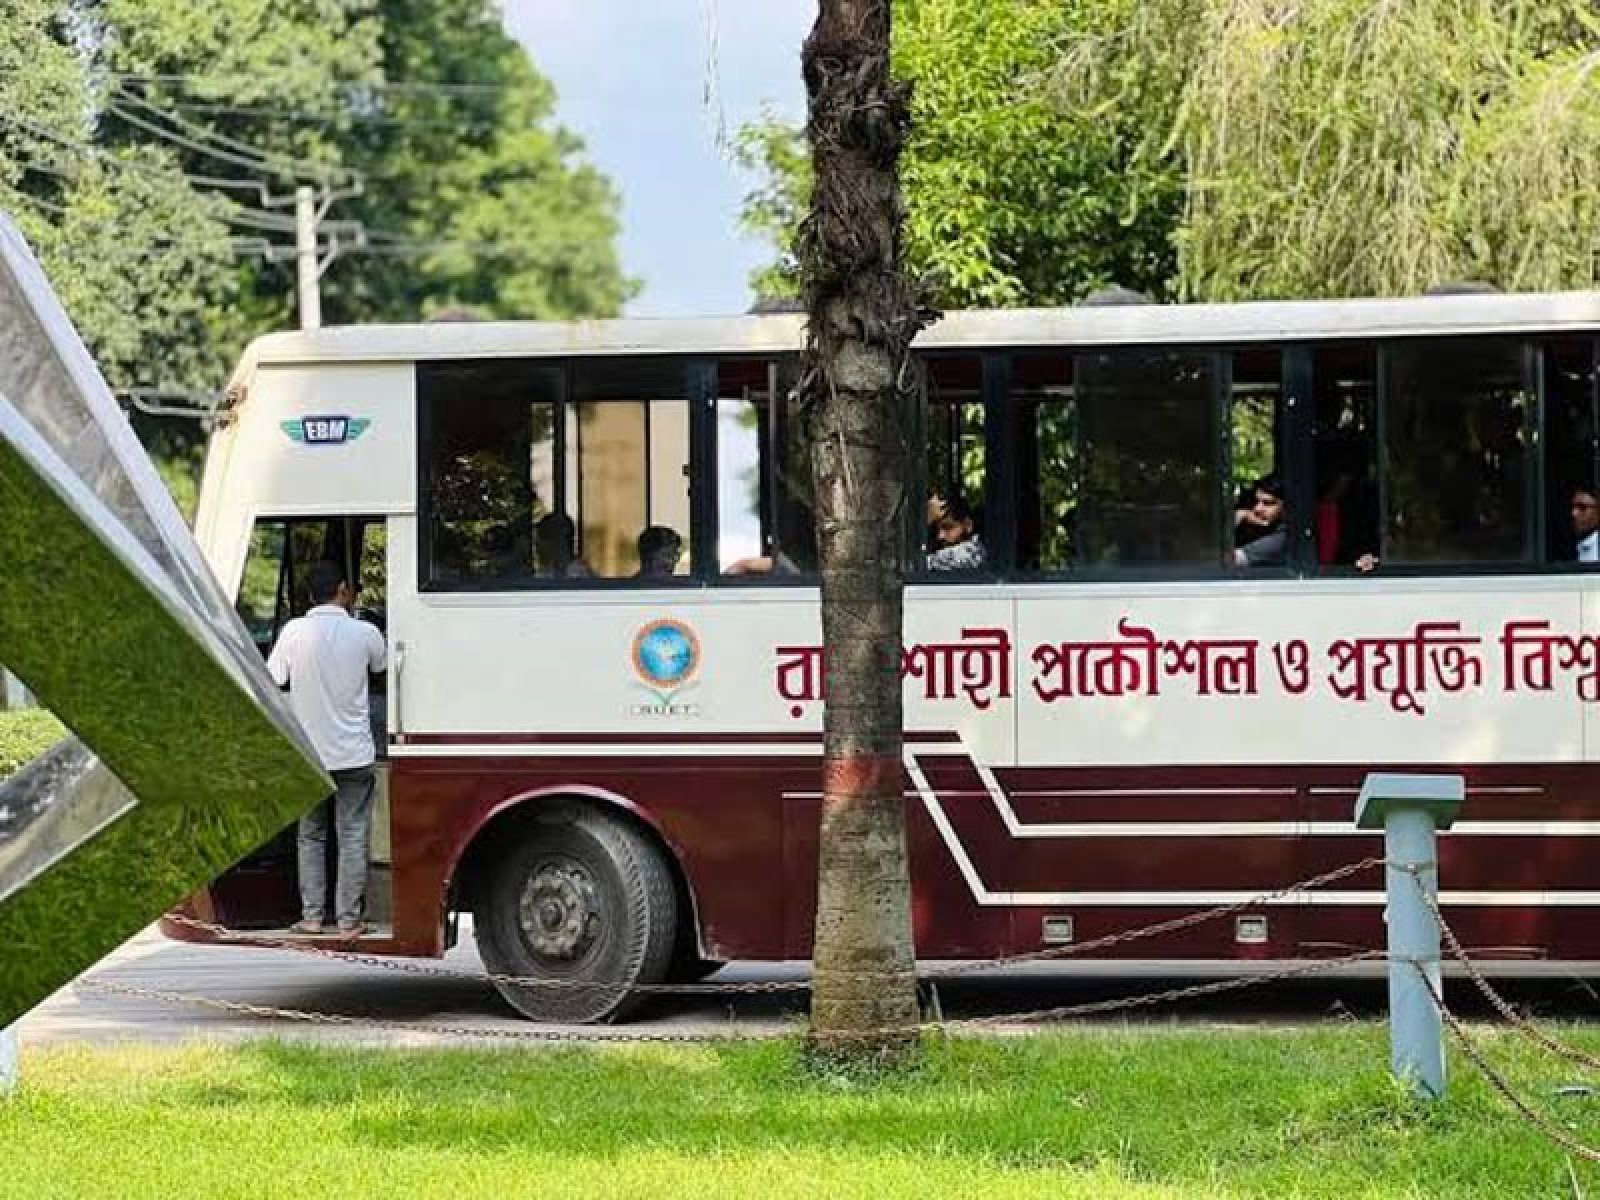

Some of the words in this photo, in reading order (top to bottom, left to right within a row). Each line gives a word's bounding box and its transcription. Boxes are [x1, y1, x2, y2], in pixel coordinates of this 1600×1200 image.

[306, 421, 345, 440] EBM
[776, 628, 1011, 718] রাশাহী
[1031, 617, 1259, 702] প্রকৌশল
[1272, 639, 1310, 693] ও
